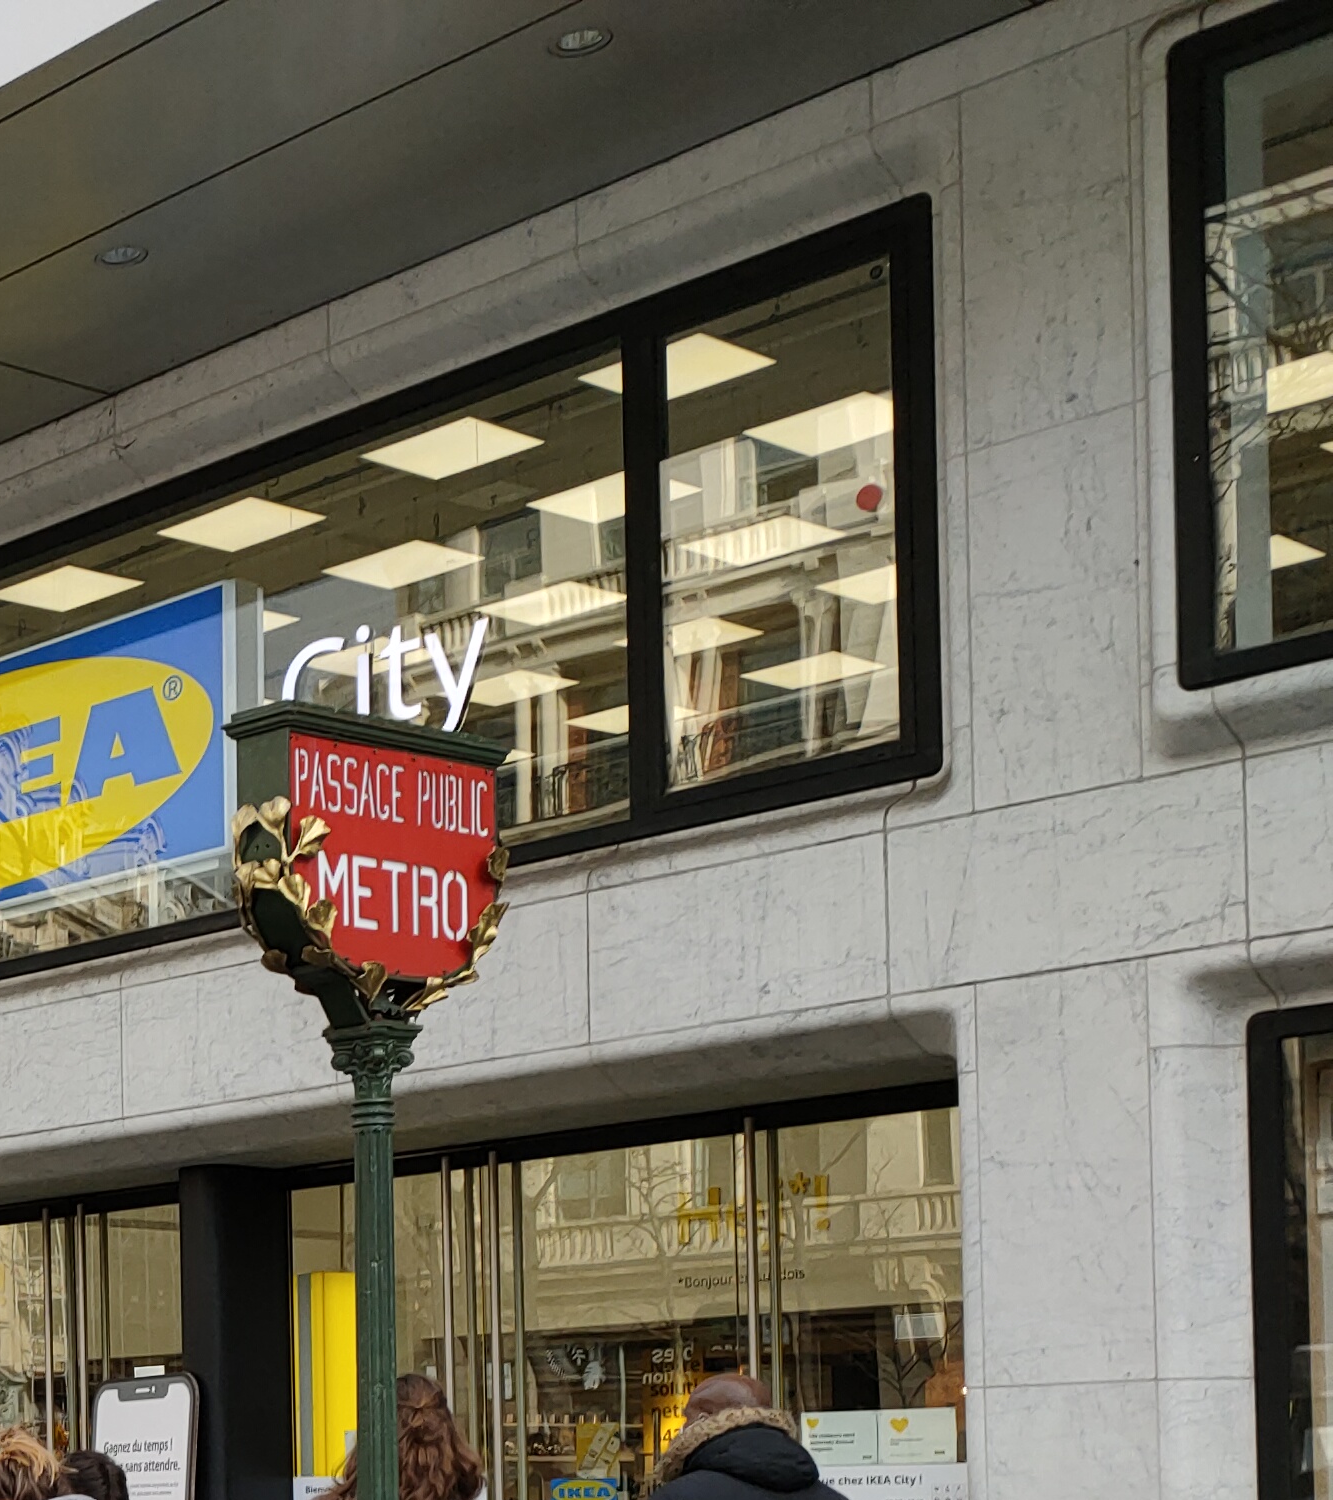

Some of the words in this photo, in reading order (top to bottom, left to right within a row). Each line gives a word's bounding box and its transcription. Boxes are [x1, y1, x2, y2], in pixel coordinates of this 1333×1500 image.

[282, 616, 489, 732] city
[295, 747, 405, 824] PASSAGE
[417, 769, 490, 838] PUBLIC
[318, 850, 469, 942] METRO
[103, 1442, 131, 1456] Gagnez
[132, 1440, 143, 1452] du
[144, 1440, 169, 1454] temps
[125, 1463, 142, 1473] sans
[144, 1459, 181, 1472] attendre.
[838, 1476, 863, 1485] chez
[866, 1476, 892, 1485] IKEA
[894, 1475, 916, 1487] City
[558, 1486, 612, 1498] IKEA
